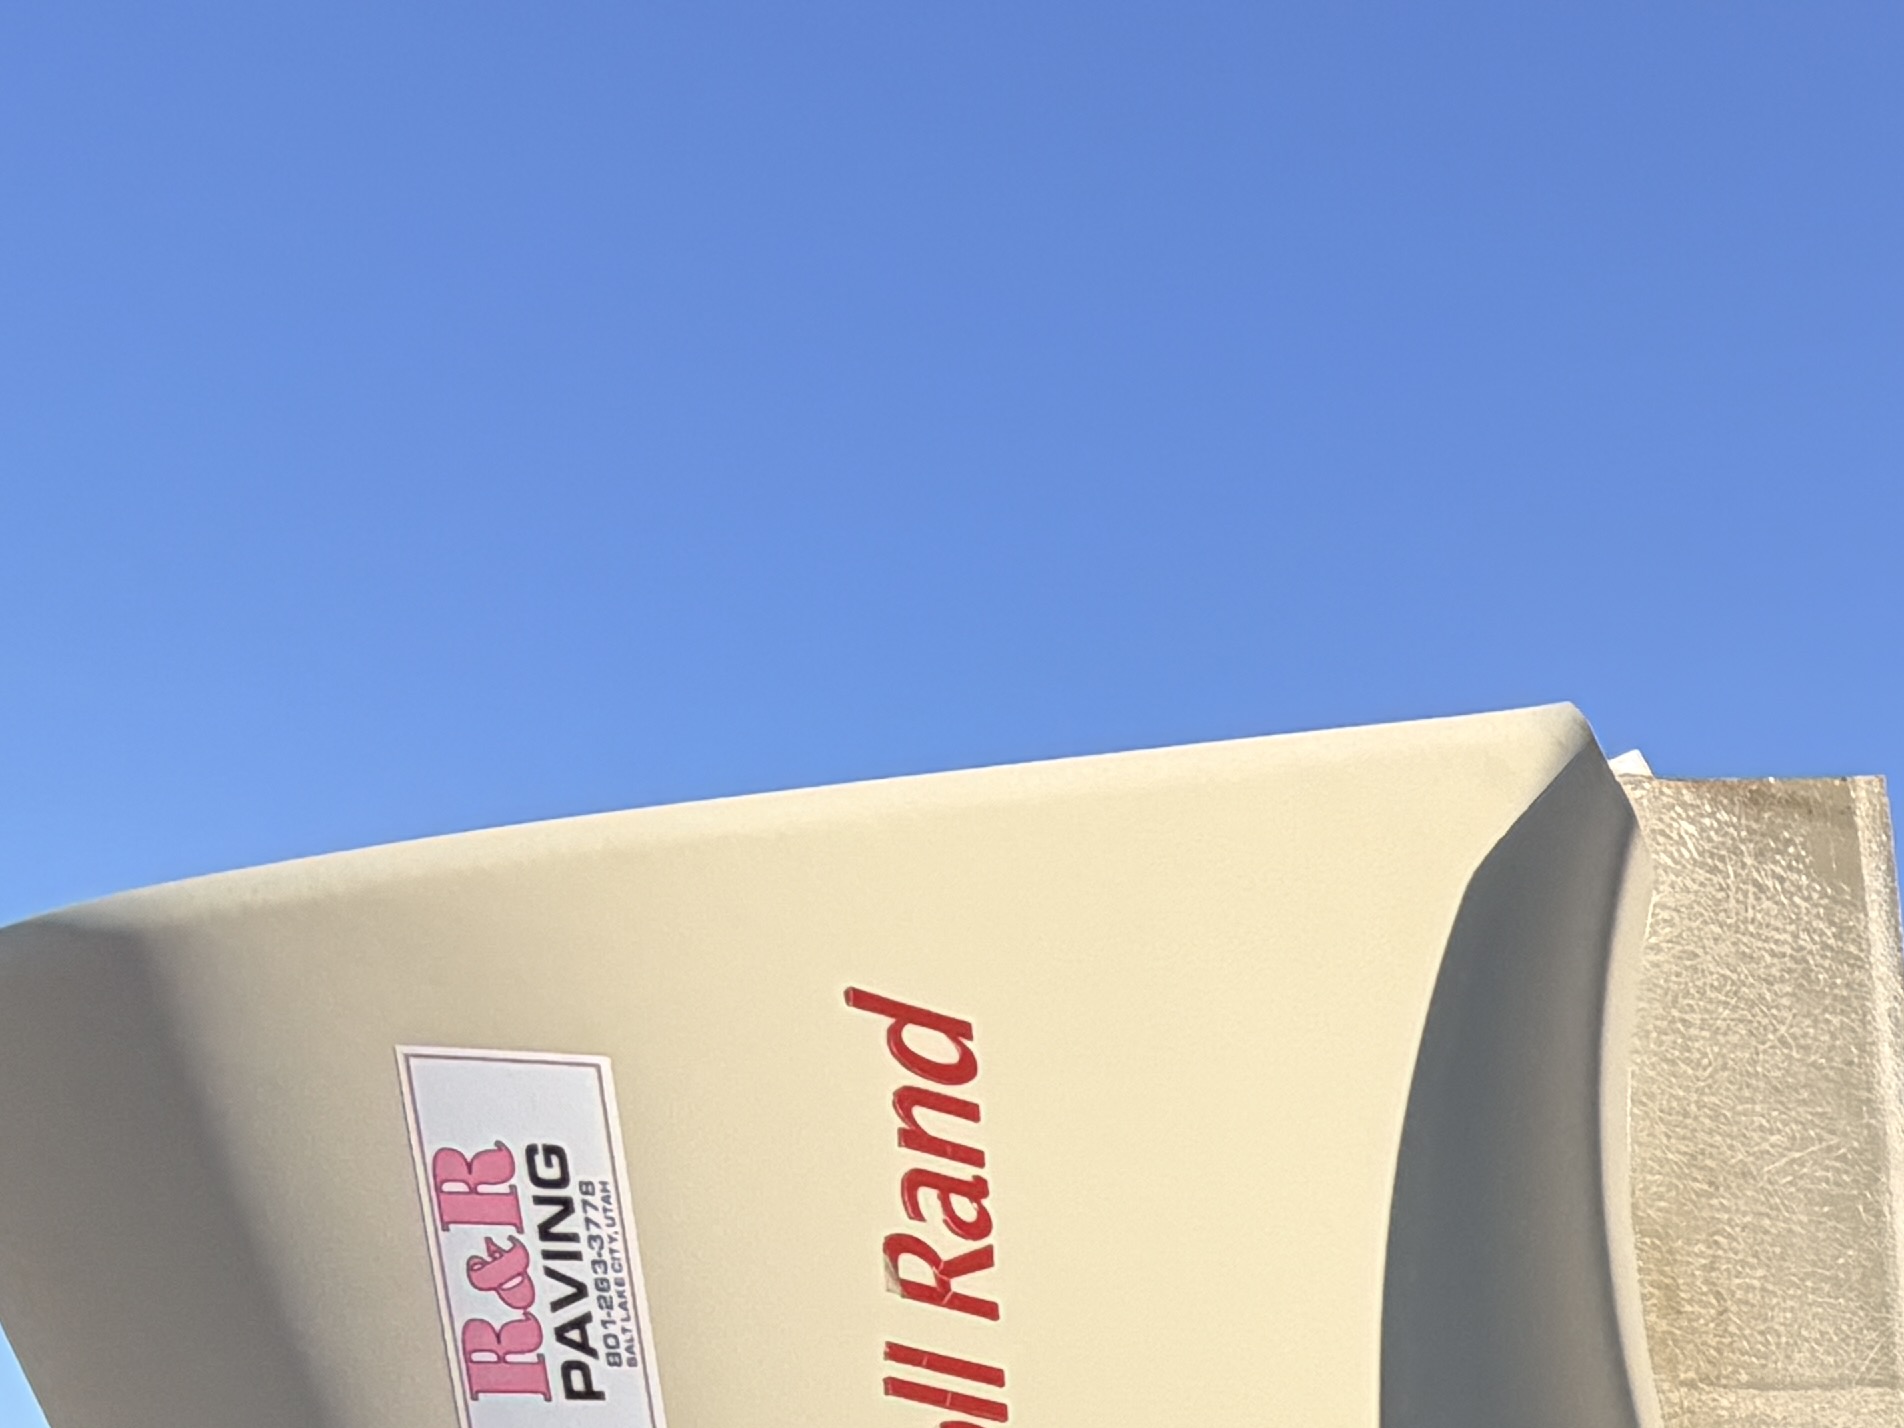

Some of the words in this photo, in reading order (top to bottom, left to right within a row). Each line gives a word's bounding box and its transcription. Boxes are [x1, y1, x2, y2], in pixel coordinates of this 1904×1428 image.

[597, 1180, 617, 1228] UTAH
[844, 986, 1000, 1322] Rand
[431, 1139, 553, 1401] R&R
[525, 1142, 606, 1402] PAVING
[612, 1276, 631, 1322] LAKE
[619, 1324, 638, 1366] SALT
